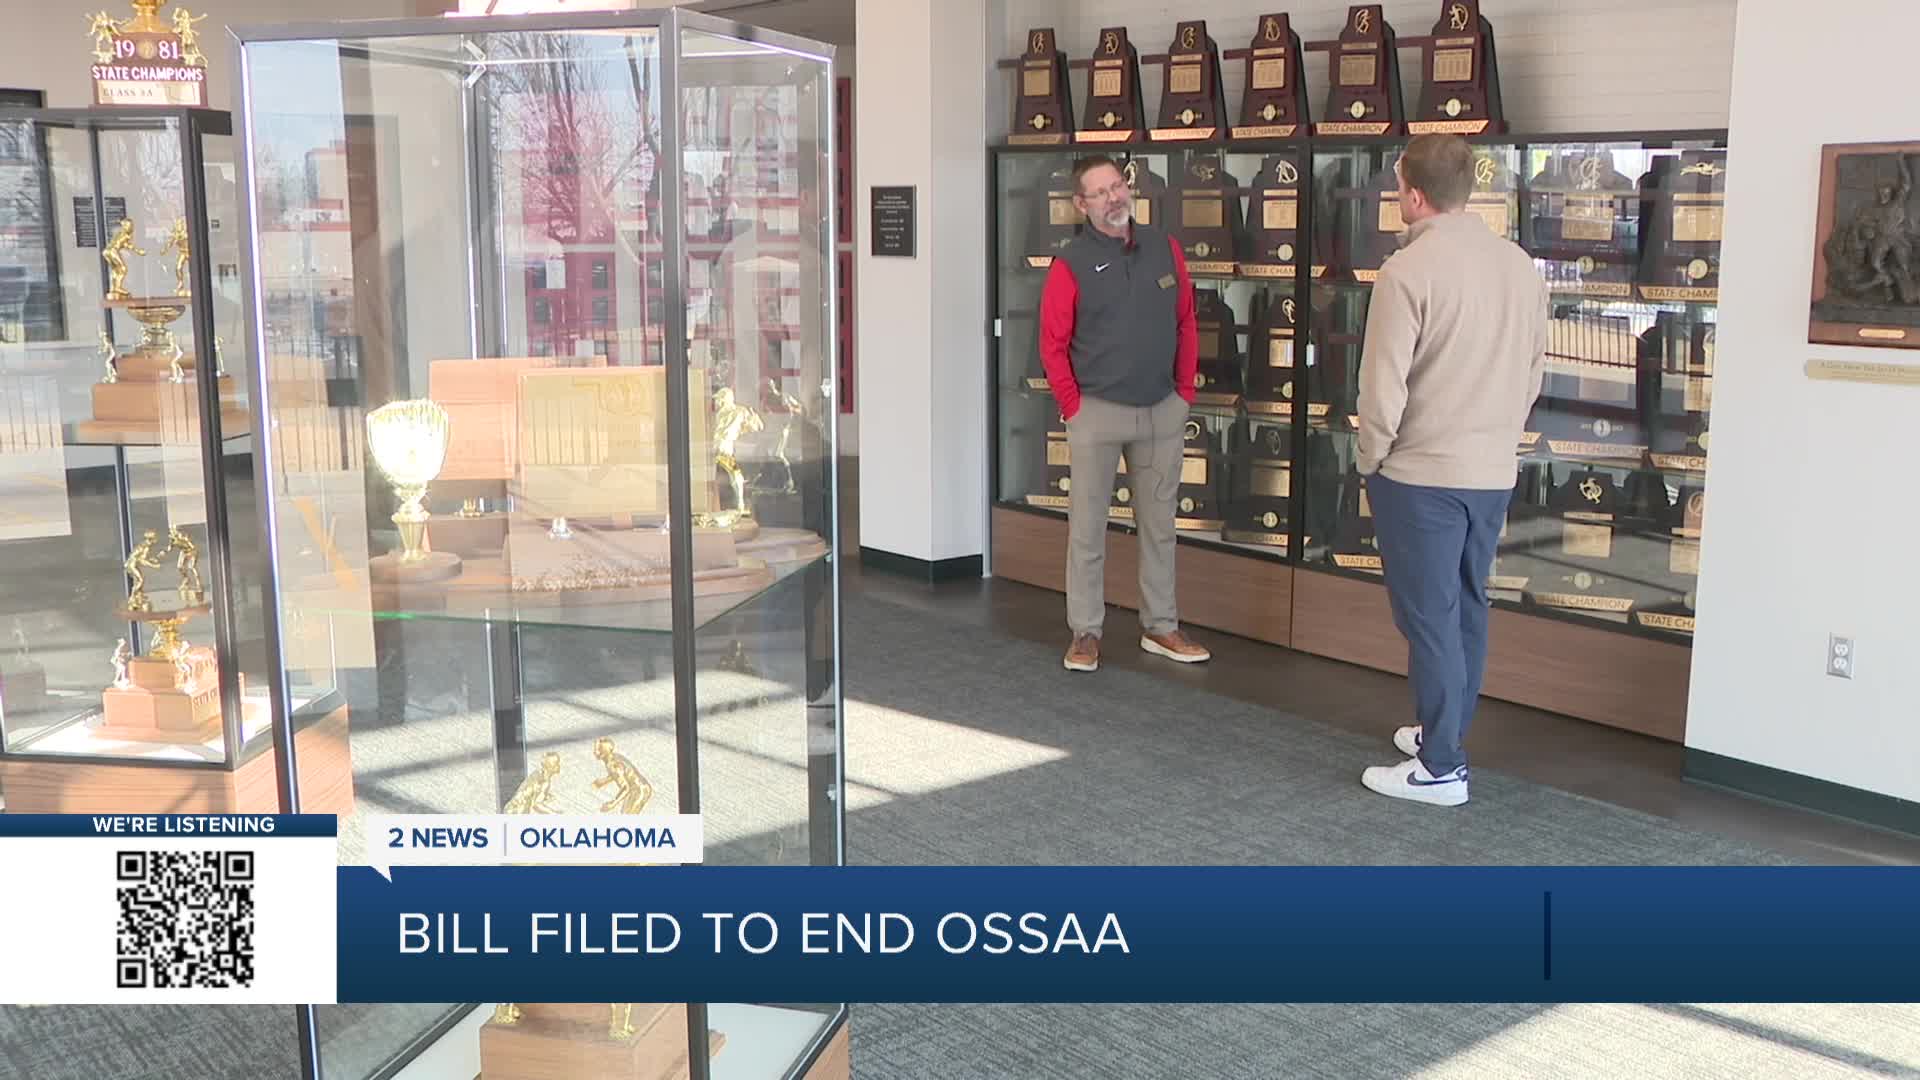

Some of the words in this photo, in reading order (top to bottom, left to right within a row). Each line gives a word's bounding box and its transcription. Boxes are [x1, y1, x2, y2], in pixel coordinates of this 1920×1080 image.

[115, 39, 135, 59] 19
[158, 40, 179, 60] 81
[92, 66, 129, 80] STATE
[131, 66, 203, 81] CHAMPIONS
[1340, 122, 1382, 132] CHAMPION
[1434, 121, 1481, 132] CHAMPION
[1647, 288, 1678, 298] STATE
[1340, 555, 1364, 565] STATE
[1568, 595, 1625, 610] CHAMPION
[1644, 614, 1674, 625] STATE
